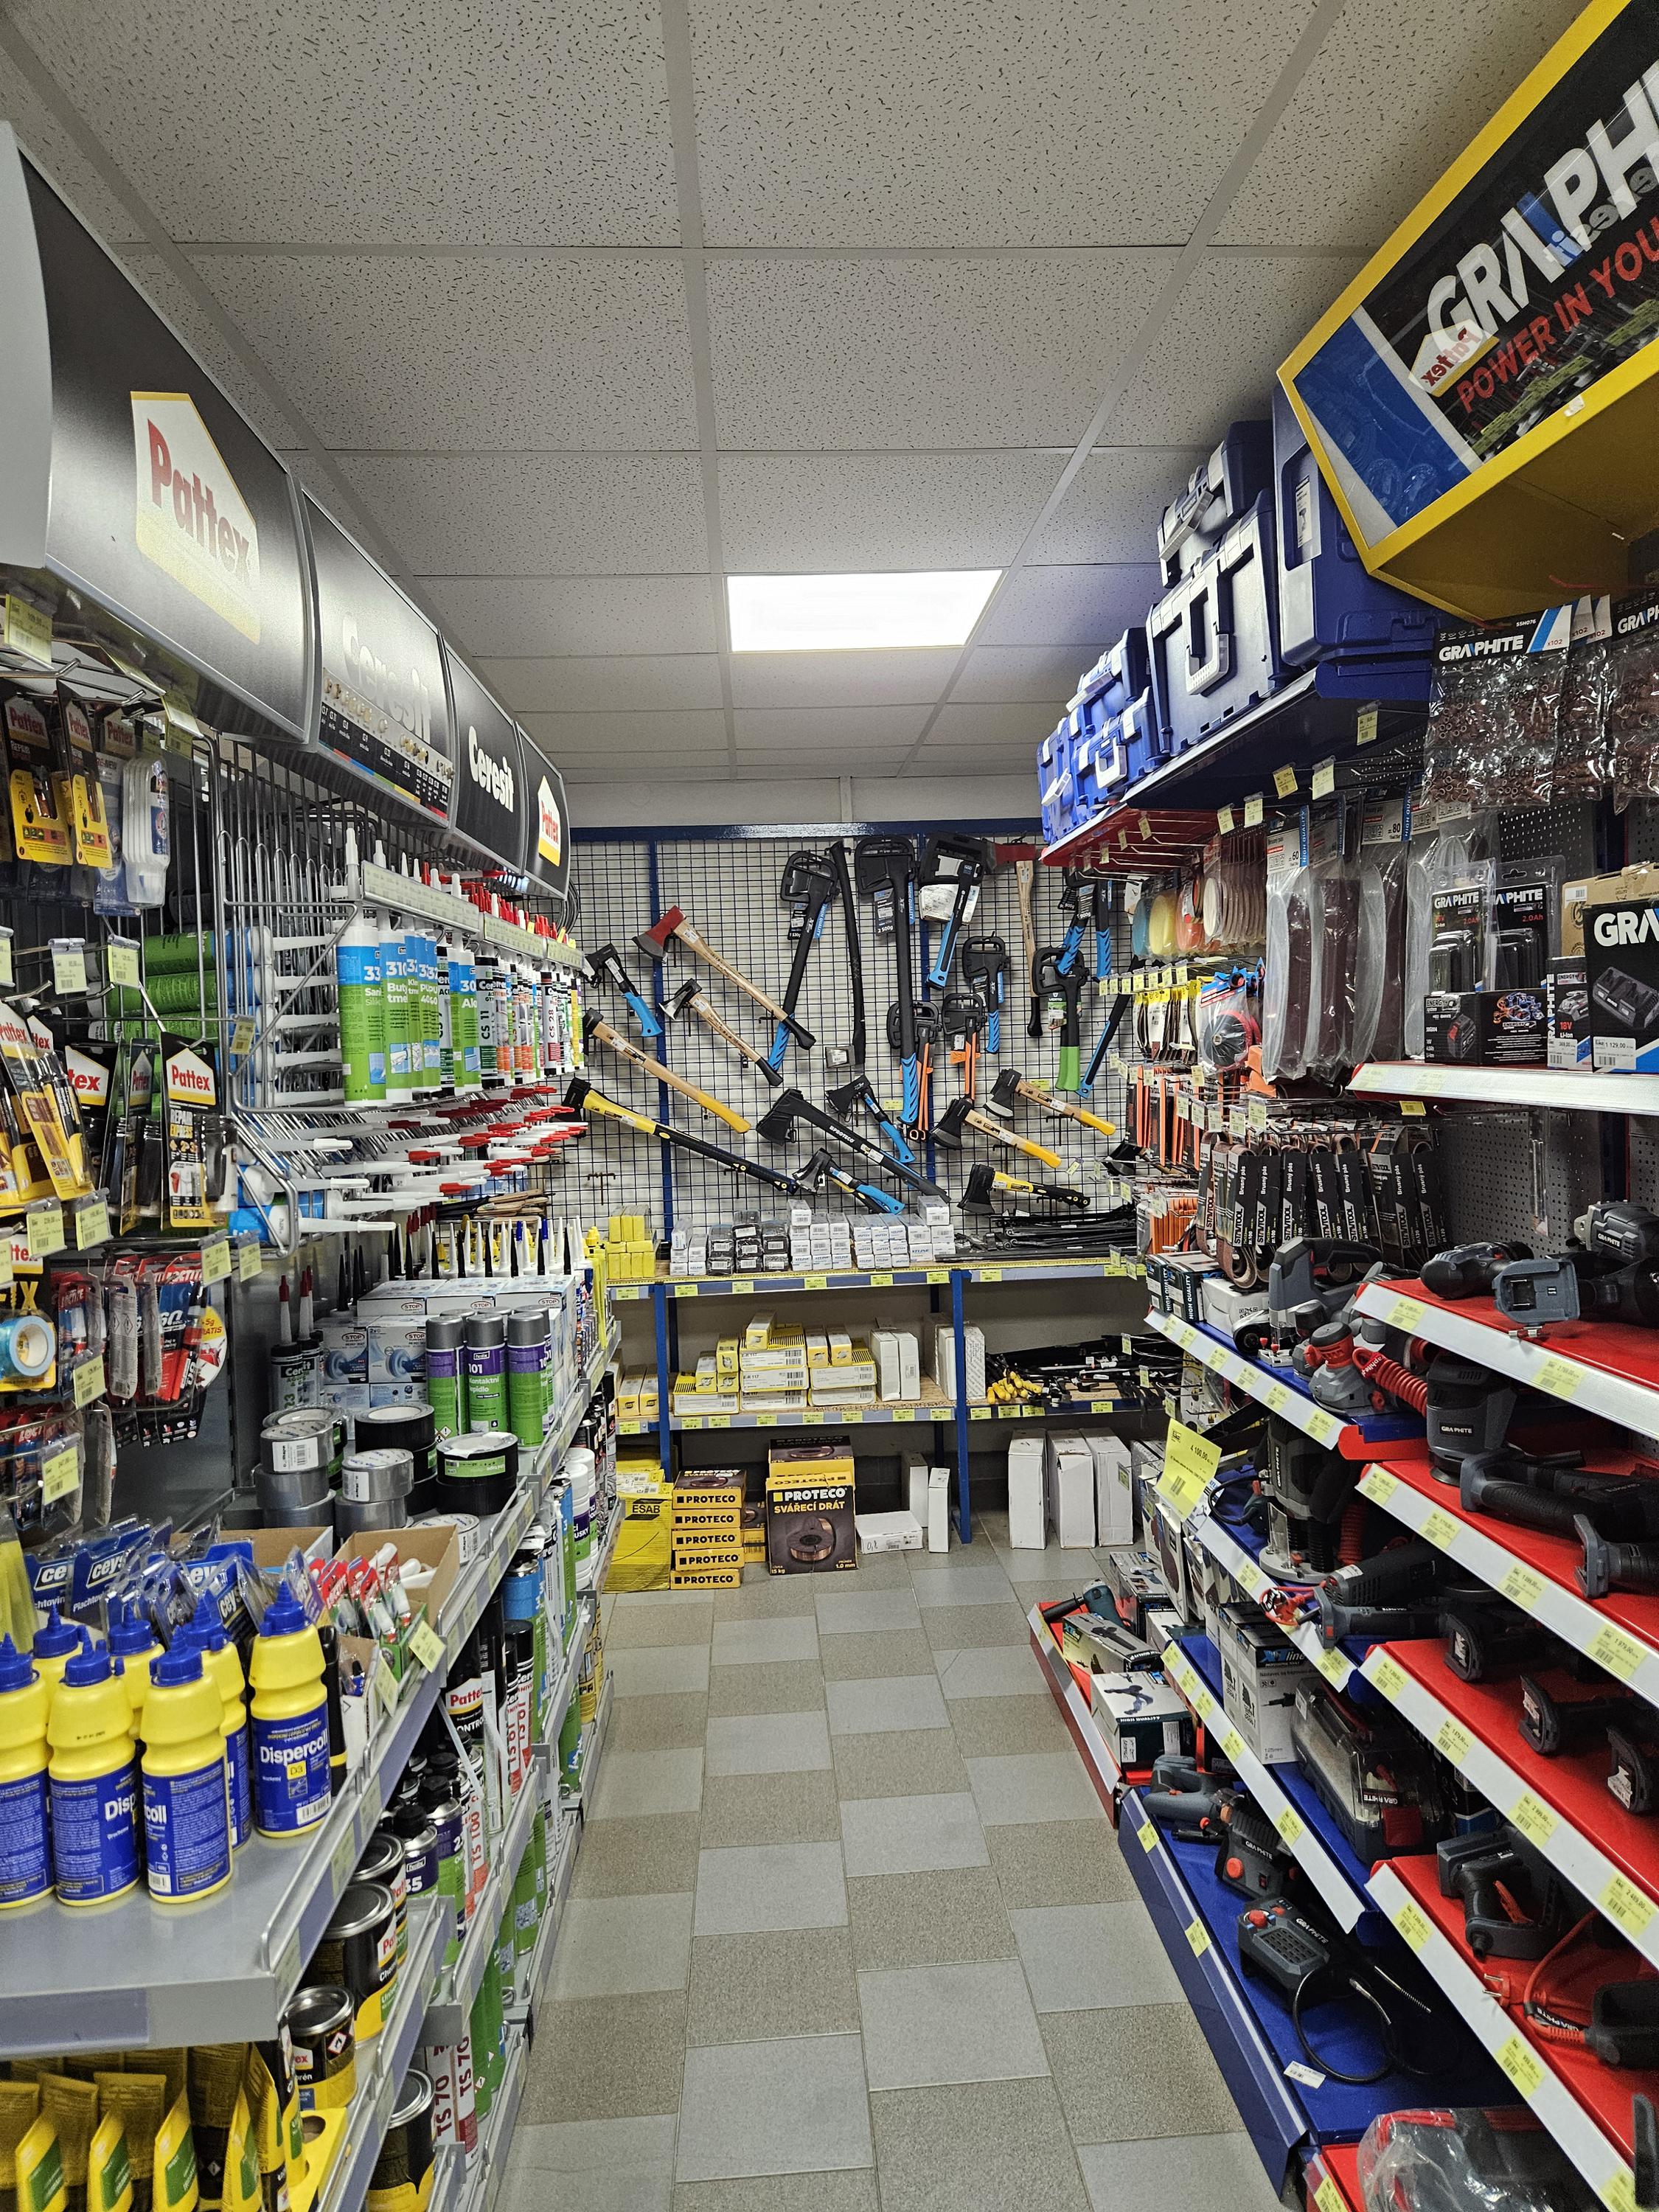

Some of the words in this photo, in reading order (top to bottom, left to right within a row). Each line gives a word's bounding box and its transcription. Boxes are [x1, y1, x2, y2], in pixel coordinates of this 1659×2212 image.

[1427, 59, 1659, 362] GRAPH
[1456, 316, 1557, 413] POWER
[1554, 282, 1593, 333] IN
[147, 418, 250, 586] Pattex
[1618, 605, 1659, 634] GRAPH
[1439, 636, 1524, 661] GRAPHITE
[469, 725, 514, 813] Ceresit
[541, 800, 560, 845] Pattex
[1392, 823, 1401, 833] 80
[1434, 891, 1479, 909] GRAPHITE
[1495, 888, 1543, 905] APHITE
[1547, 974, 1556, 1039] RAPHITE
[481, 1026, 490, 1039] CS
[1560, 1022, 1572, 1030] 18V
[68, 1068, 101, 1091] tex
[171, 1065, 211, 1091] Pattex
[1598, 1233, 1620, 1246] GRAPHITE
[1441, 1426, 1472, 1434] GRAPHITE
[686, 1495, 736, 1503] PROTECO
[785, 1489, 846, 1501] PROTECO
[633, 1504, 660, 1513] ESAB
[774, 1502, 816, 1514] SVÁŘECÍ
[819, 1500, 845, 1511] DRÁT
[684, 1515, 734, 1523] PROTECO
[686, 1534, 736, 1544] PROTECO
[689, 1554, 739, 1564] PROTECO
[684, 1575, 734, 1584] PROTECO
[451, 1687, 482, 1707] Patte
[260, 1730, 328, 1767] Dispercoll
[1245, 1840, 1273, 1860] GRAPHITE
[1295, 1918, 1329, 1944] GRAPHITE
[434, 2074, 451, 2101] 70
[459, 2068, 472, 2097] TS
[437, 2107, 451, 2137] TS
